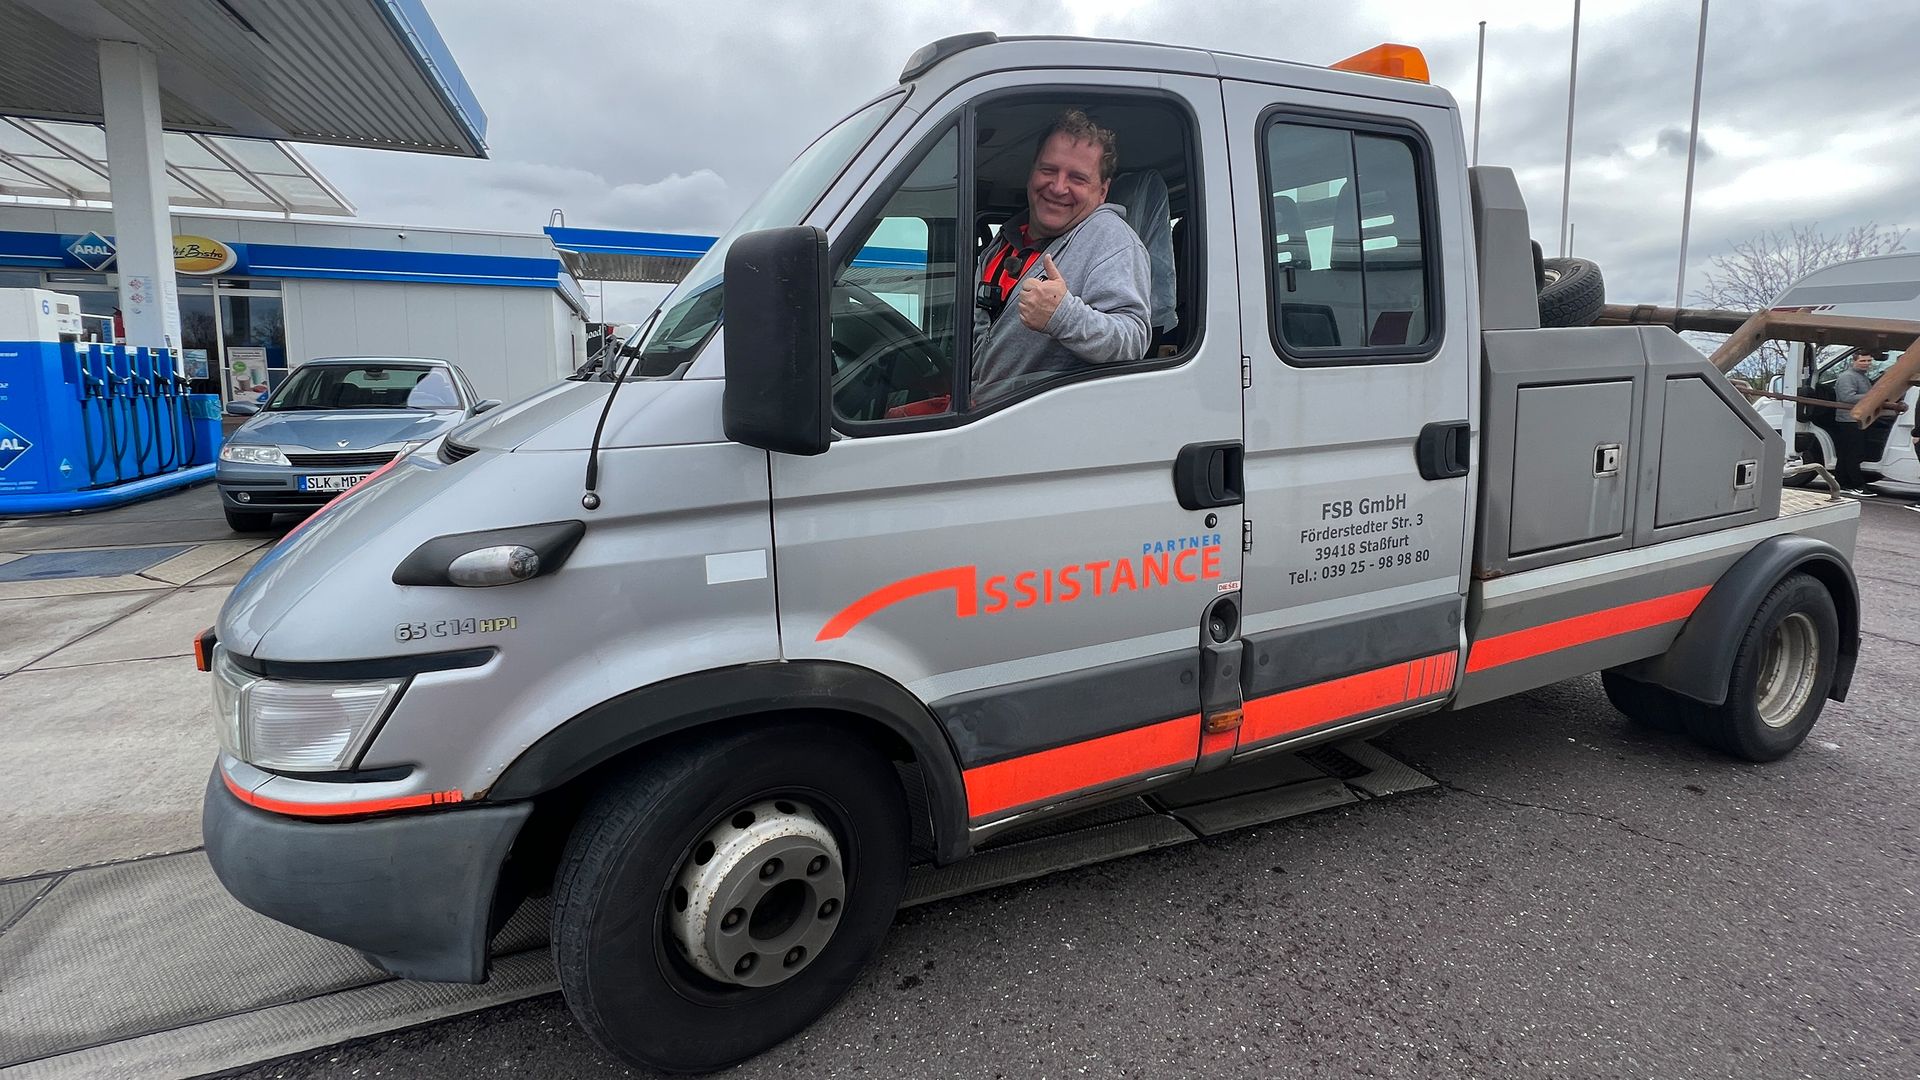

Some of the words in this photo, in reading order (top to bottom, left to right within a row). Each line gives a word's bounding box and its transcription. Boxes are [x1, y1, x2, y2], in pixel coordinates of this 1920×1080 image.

[74, 244, 112, 256] ARAL
[42, 299, 50, 316] 6
[307, 477, 332, 489] SLK
[1322, 500, 1353, 520] FSB
[1359, 493, 1406, 515] GmbH
[1300, 520, 1388, 544] Förderstedter
[1391, 516, 1412, 530] Str.
[1416, 513, 1424, 526] 3
[1143, 533, 1221, 555] PARTNER
[1314, 543, 1356, 561] 39418
[1359, 534, 1409, 554] Staßfurt
[1289, 569, 1317, 585] Tel.:
[1321, 563, 1346, 579] 039
[1350, 560, 1366, 575] 25
[1378, 555, 1393, 570] 98
[1397, 552, 1412, 566] 98
[1415, 549, 1430, 563] 80
[1218, 582, 1239, 591] DIESEL
[479, 616, 518, 633] HPI
